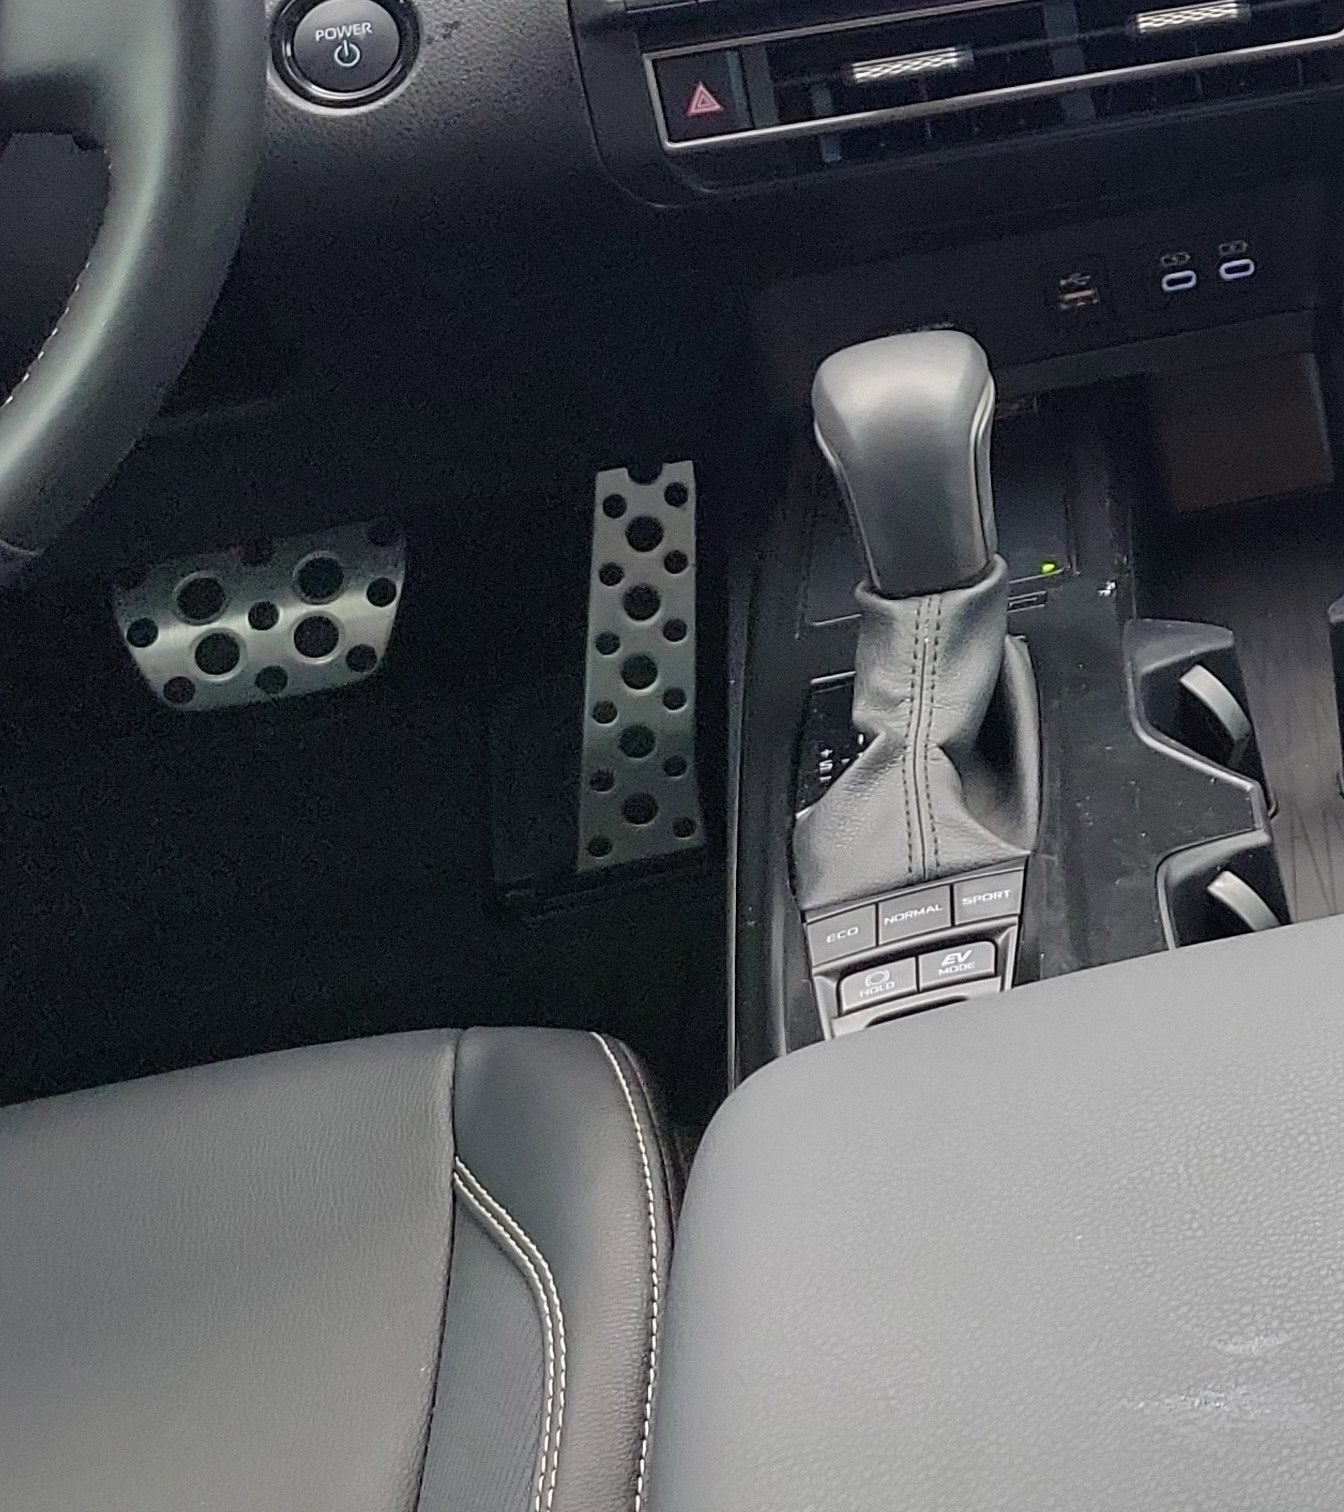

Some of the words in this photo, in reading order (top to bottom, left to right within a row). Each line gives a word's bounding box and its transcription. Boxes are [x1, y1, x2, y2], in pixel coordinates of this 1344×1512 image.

[315, 22, 373, 41] POWER
[961, 889, 1012, 906] SPORT
[884, 903, 944, 926] NORMAL
[826, 925, 860, 944] ECO
[941, 949, 974, 967] EV
[937, 961, 977, 976] MODE
[859, 981, 896, 998] HOLD
